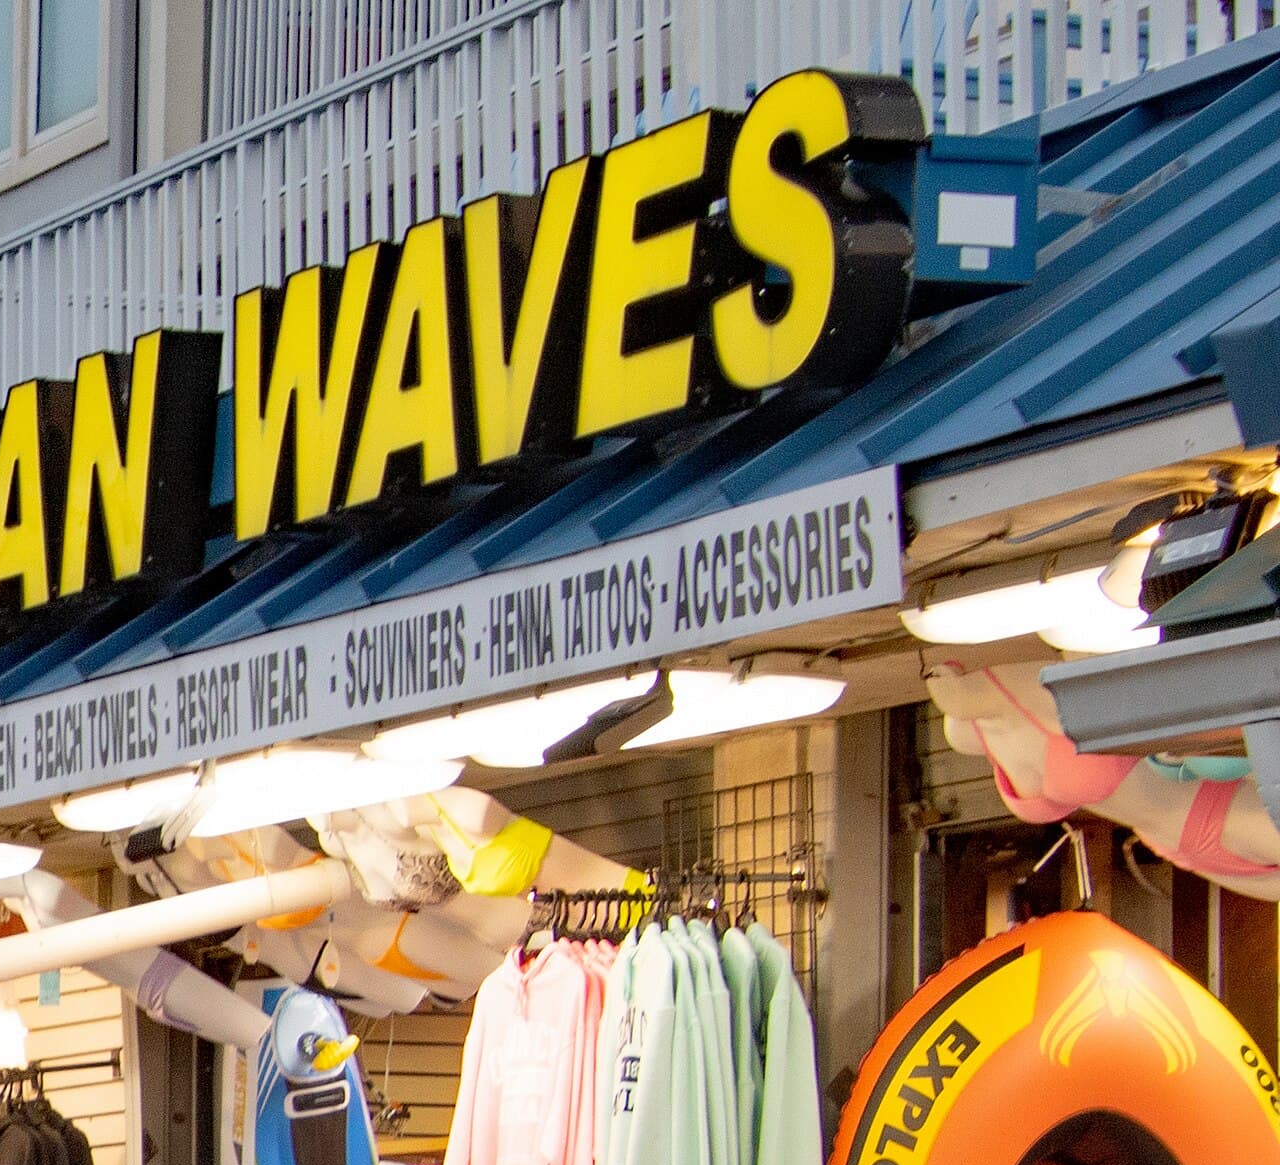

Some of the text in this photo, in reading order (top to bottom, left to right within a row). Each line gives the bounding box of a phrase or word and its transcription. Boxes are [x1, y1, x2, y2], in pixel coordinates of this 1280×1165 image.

[233, 68, 851, 542] WAVES
[34, 704, 83, 782] BEACH
[87, 683, 159, 770] TOWELS
[177, 662, 241, 750] RESORT
[248, 643, 310, 732] WEAR
[343, 604, 466, 709] SOUVINIERS
[488, 581, 555, 679] HENNA
[560, 555, 654, 660] TATTOOS
[674, 494, 875, 634] ACCESSORIES
